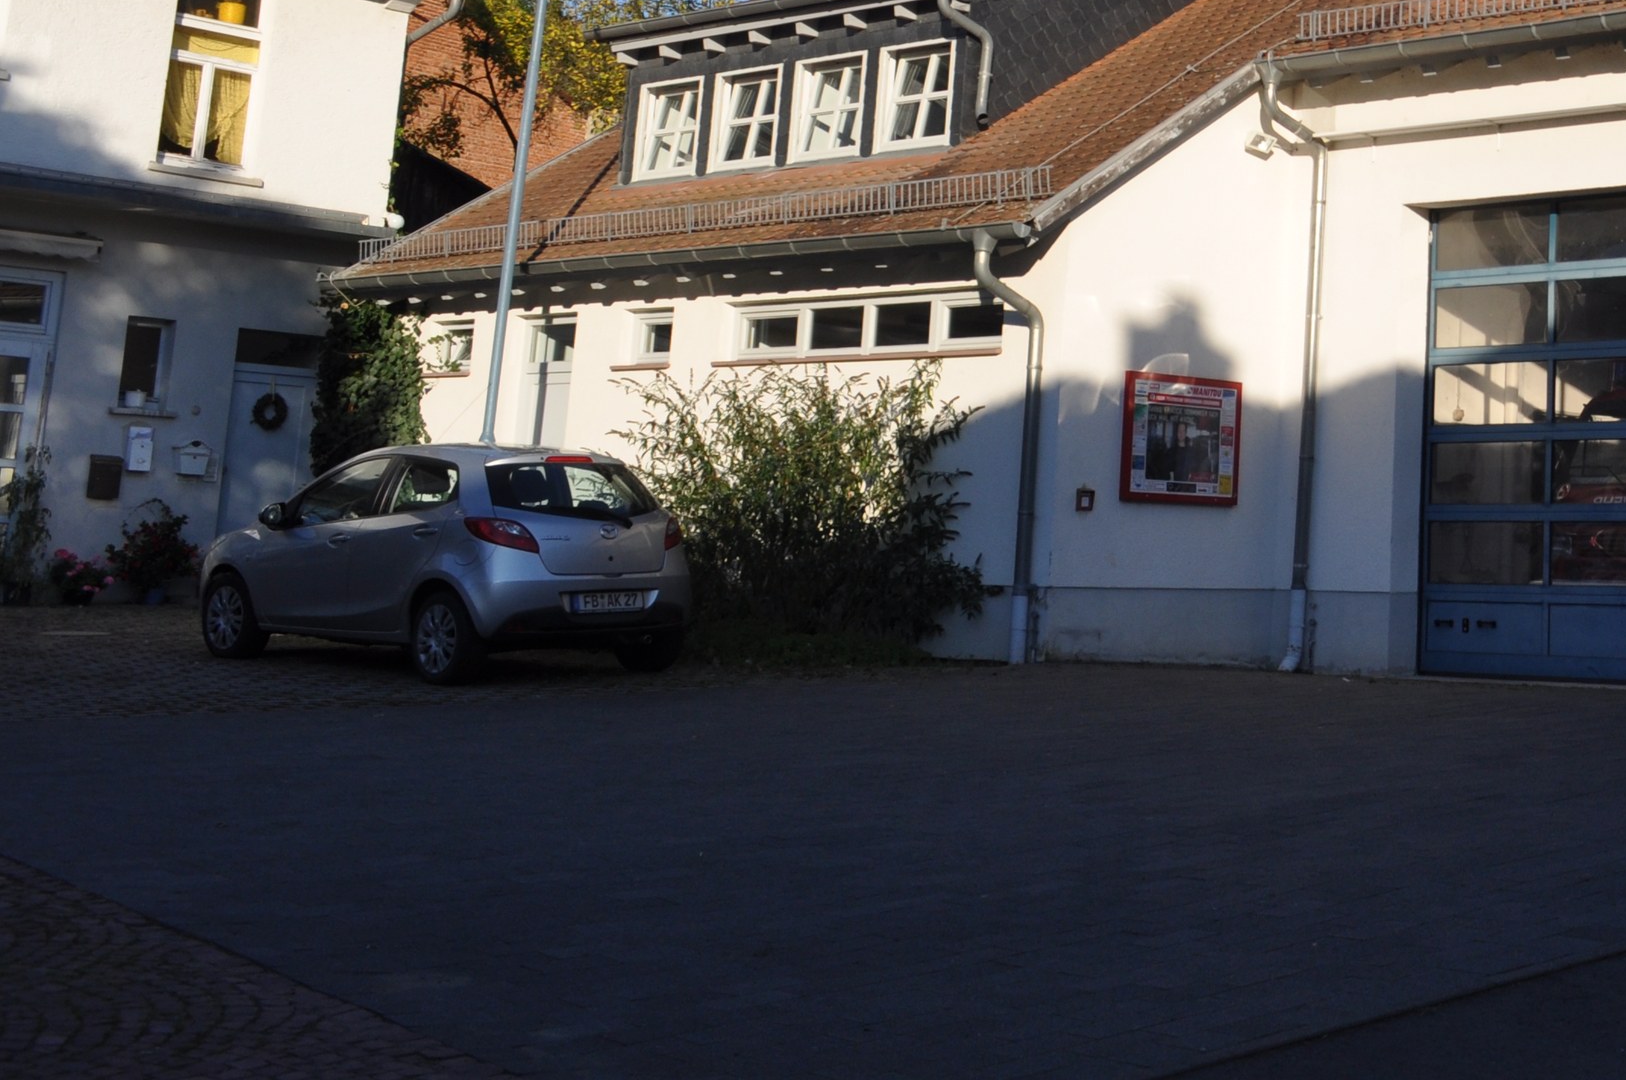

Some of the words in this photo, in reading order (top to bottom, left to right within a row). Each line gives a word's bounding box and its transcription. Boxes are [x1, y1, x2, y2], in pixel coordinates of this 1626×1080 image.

[583, 594, 600, 608] FB
[607, 594, 622, 607] AK
[624, 593, 638, 607] 27
